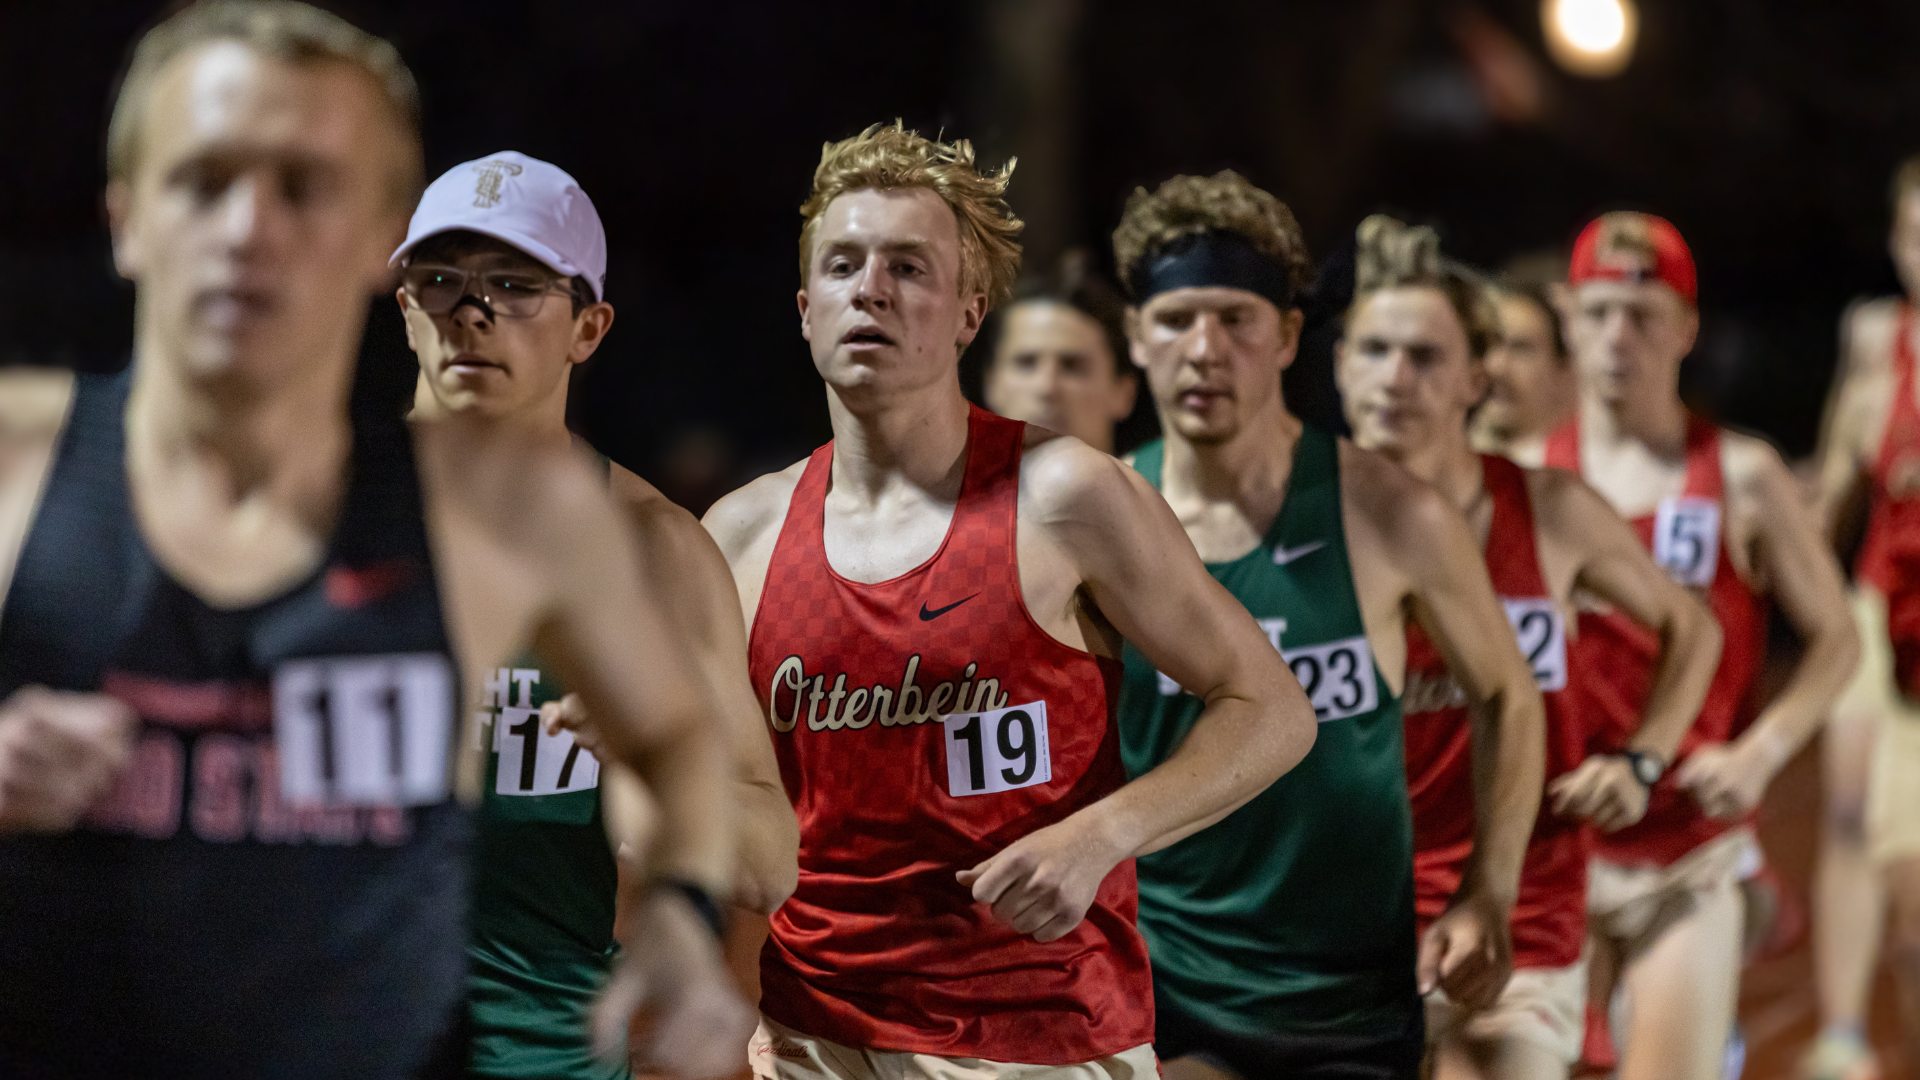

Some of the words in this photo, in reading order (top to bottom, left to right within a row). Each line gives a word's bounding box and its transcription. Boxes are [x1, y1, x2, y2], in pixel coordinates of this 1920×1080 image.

[1669, 513, 1703, 581] 5
[770, 653, 1010, 733] Otterbein
[1289, 648, 1363, 716] 23
[303, 683, 403, 781] 11
[953, 709, 1037, 791] 19
